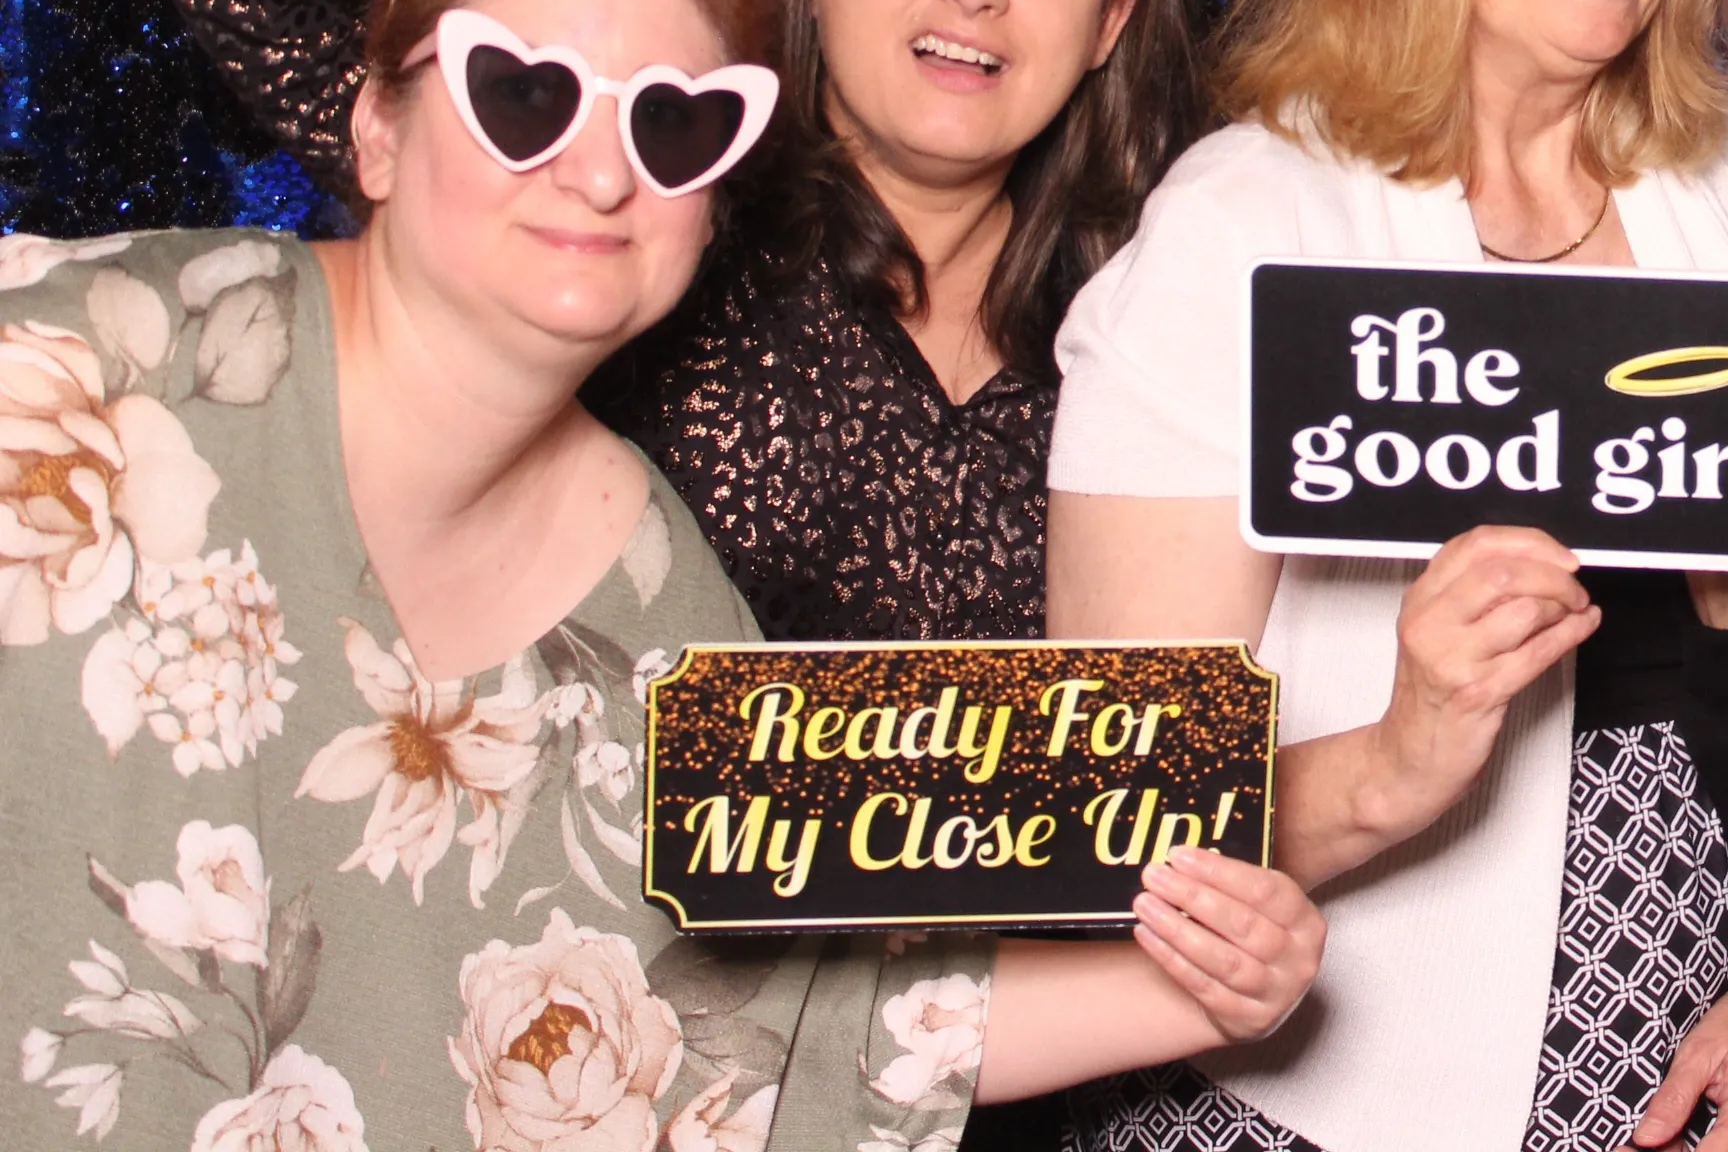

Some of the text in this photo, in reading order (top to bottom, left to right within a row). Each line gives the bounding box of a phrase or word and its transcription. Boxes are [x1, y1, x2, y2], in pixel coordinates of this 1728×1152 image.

[1350, 307, 1520, 406] the
[1290, 409, 1562, 503] good
[739, 678, 1182, 784] Ready For
[684, 788, 1238, 898] My Close Up!
